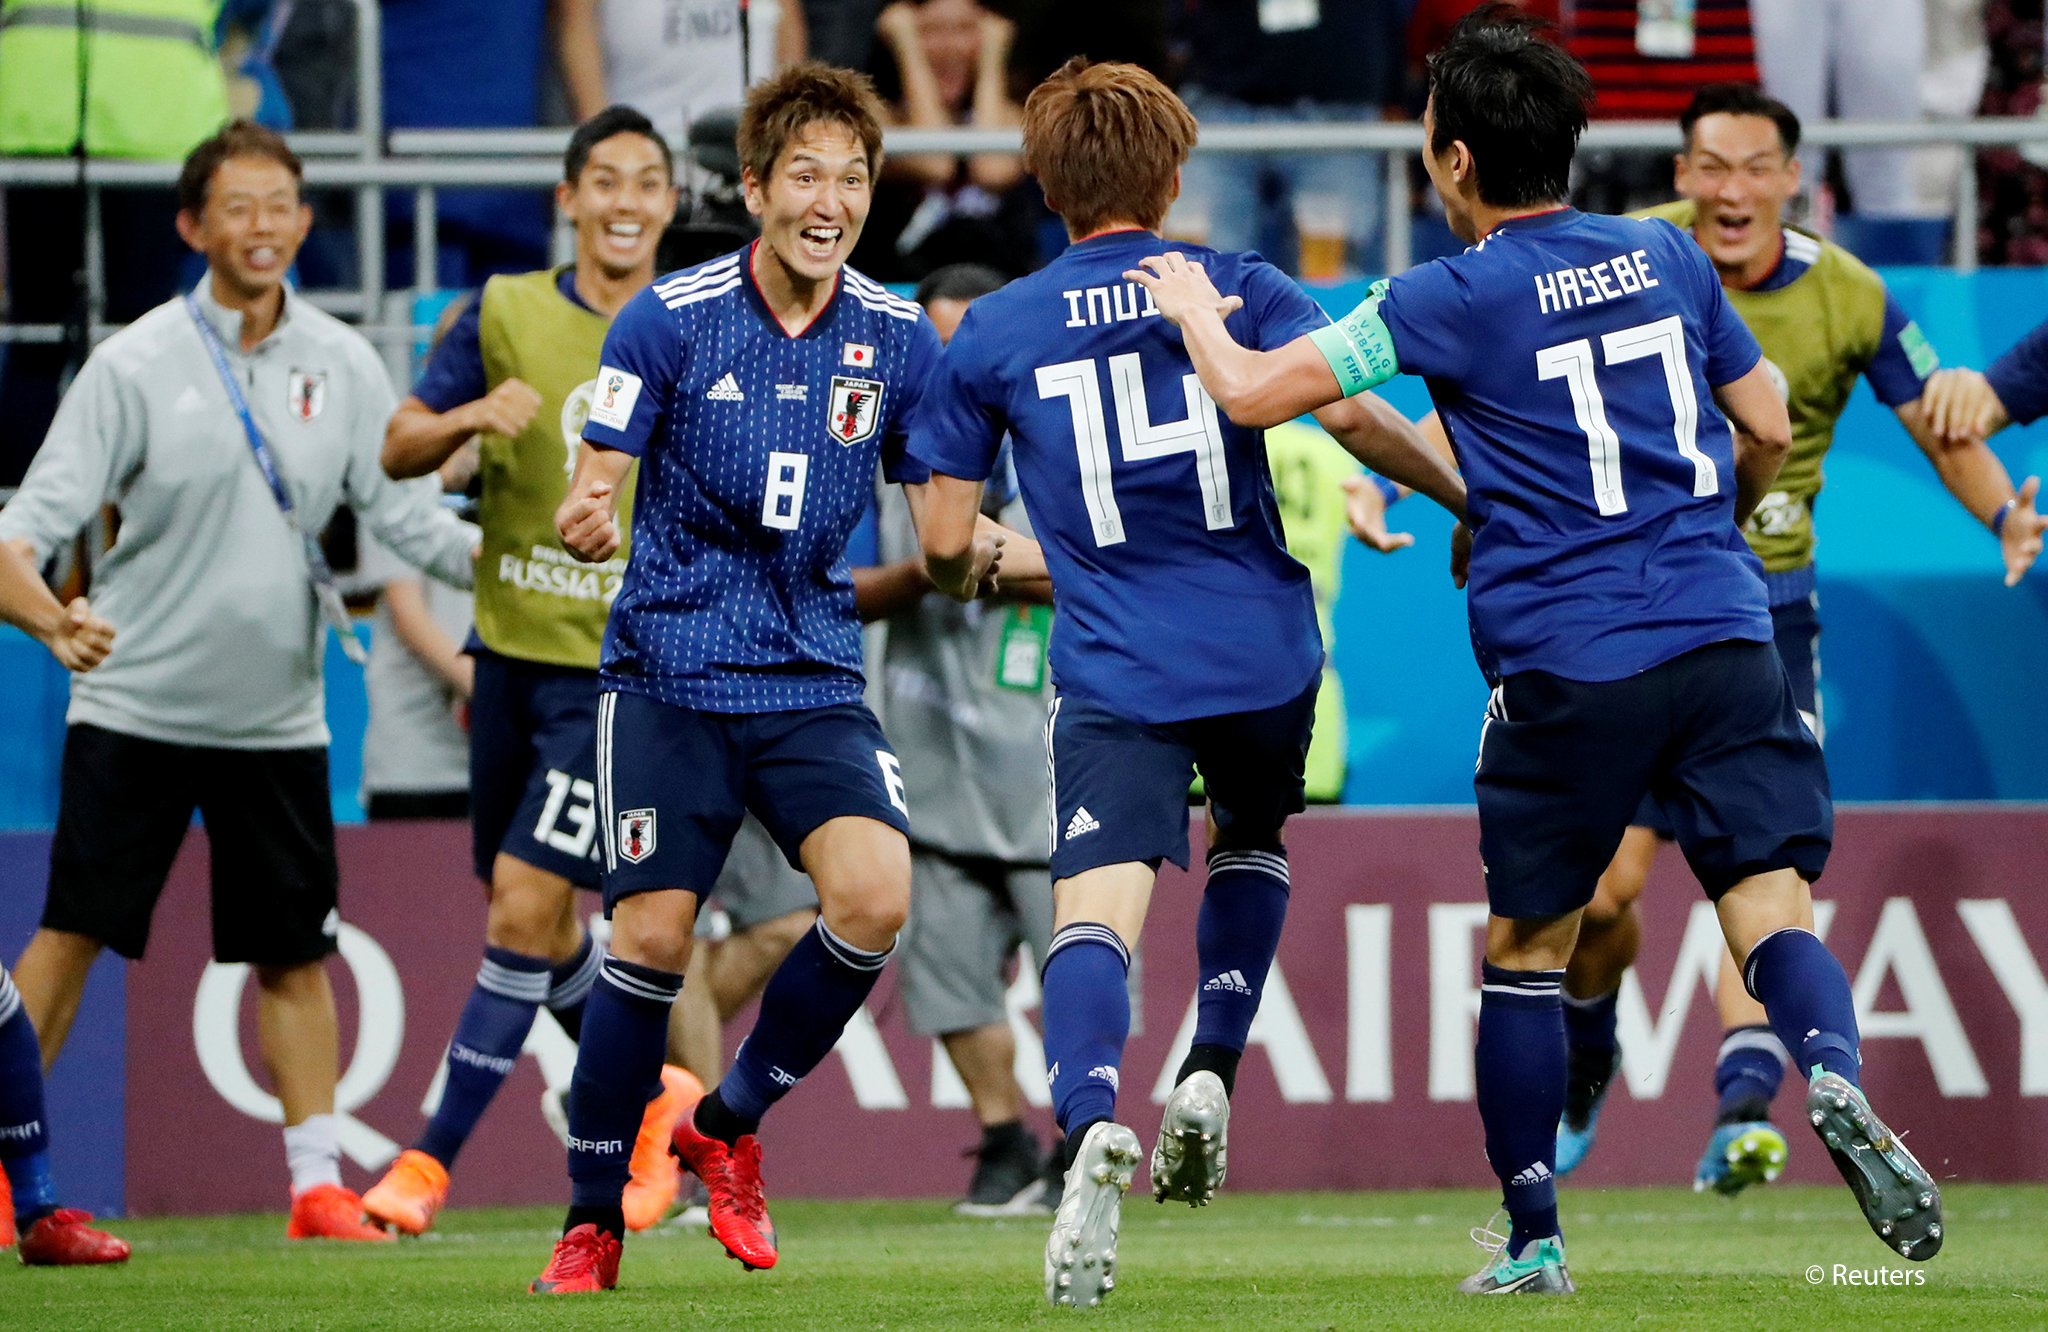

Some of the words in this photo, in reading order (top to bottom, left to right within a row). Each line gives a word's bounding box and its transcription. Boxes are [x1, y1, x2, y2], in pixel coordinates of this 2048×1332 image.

[1062, 282, 1161, 328] INUI
[1534, 249, 1660, 315] HASEBE
[843, 379, 870, 390] JAPAN
[1343, 354, 1364, 385] FIFA
[706, 386, 745, 401] adidas
[1536, 314, 1719, 516] 17
[1034, 352, 1235, 548] 14
[761, 451, 808, 531] 8
[499, 553, 600, 599] RUSSIA
[533, 768, 597, 858] 13
[1064, 820, 1101, 841] adidas
[1203, 980, 1252, 996] adidas
[451, 1041, 515, 1074] JAPAN
